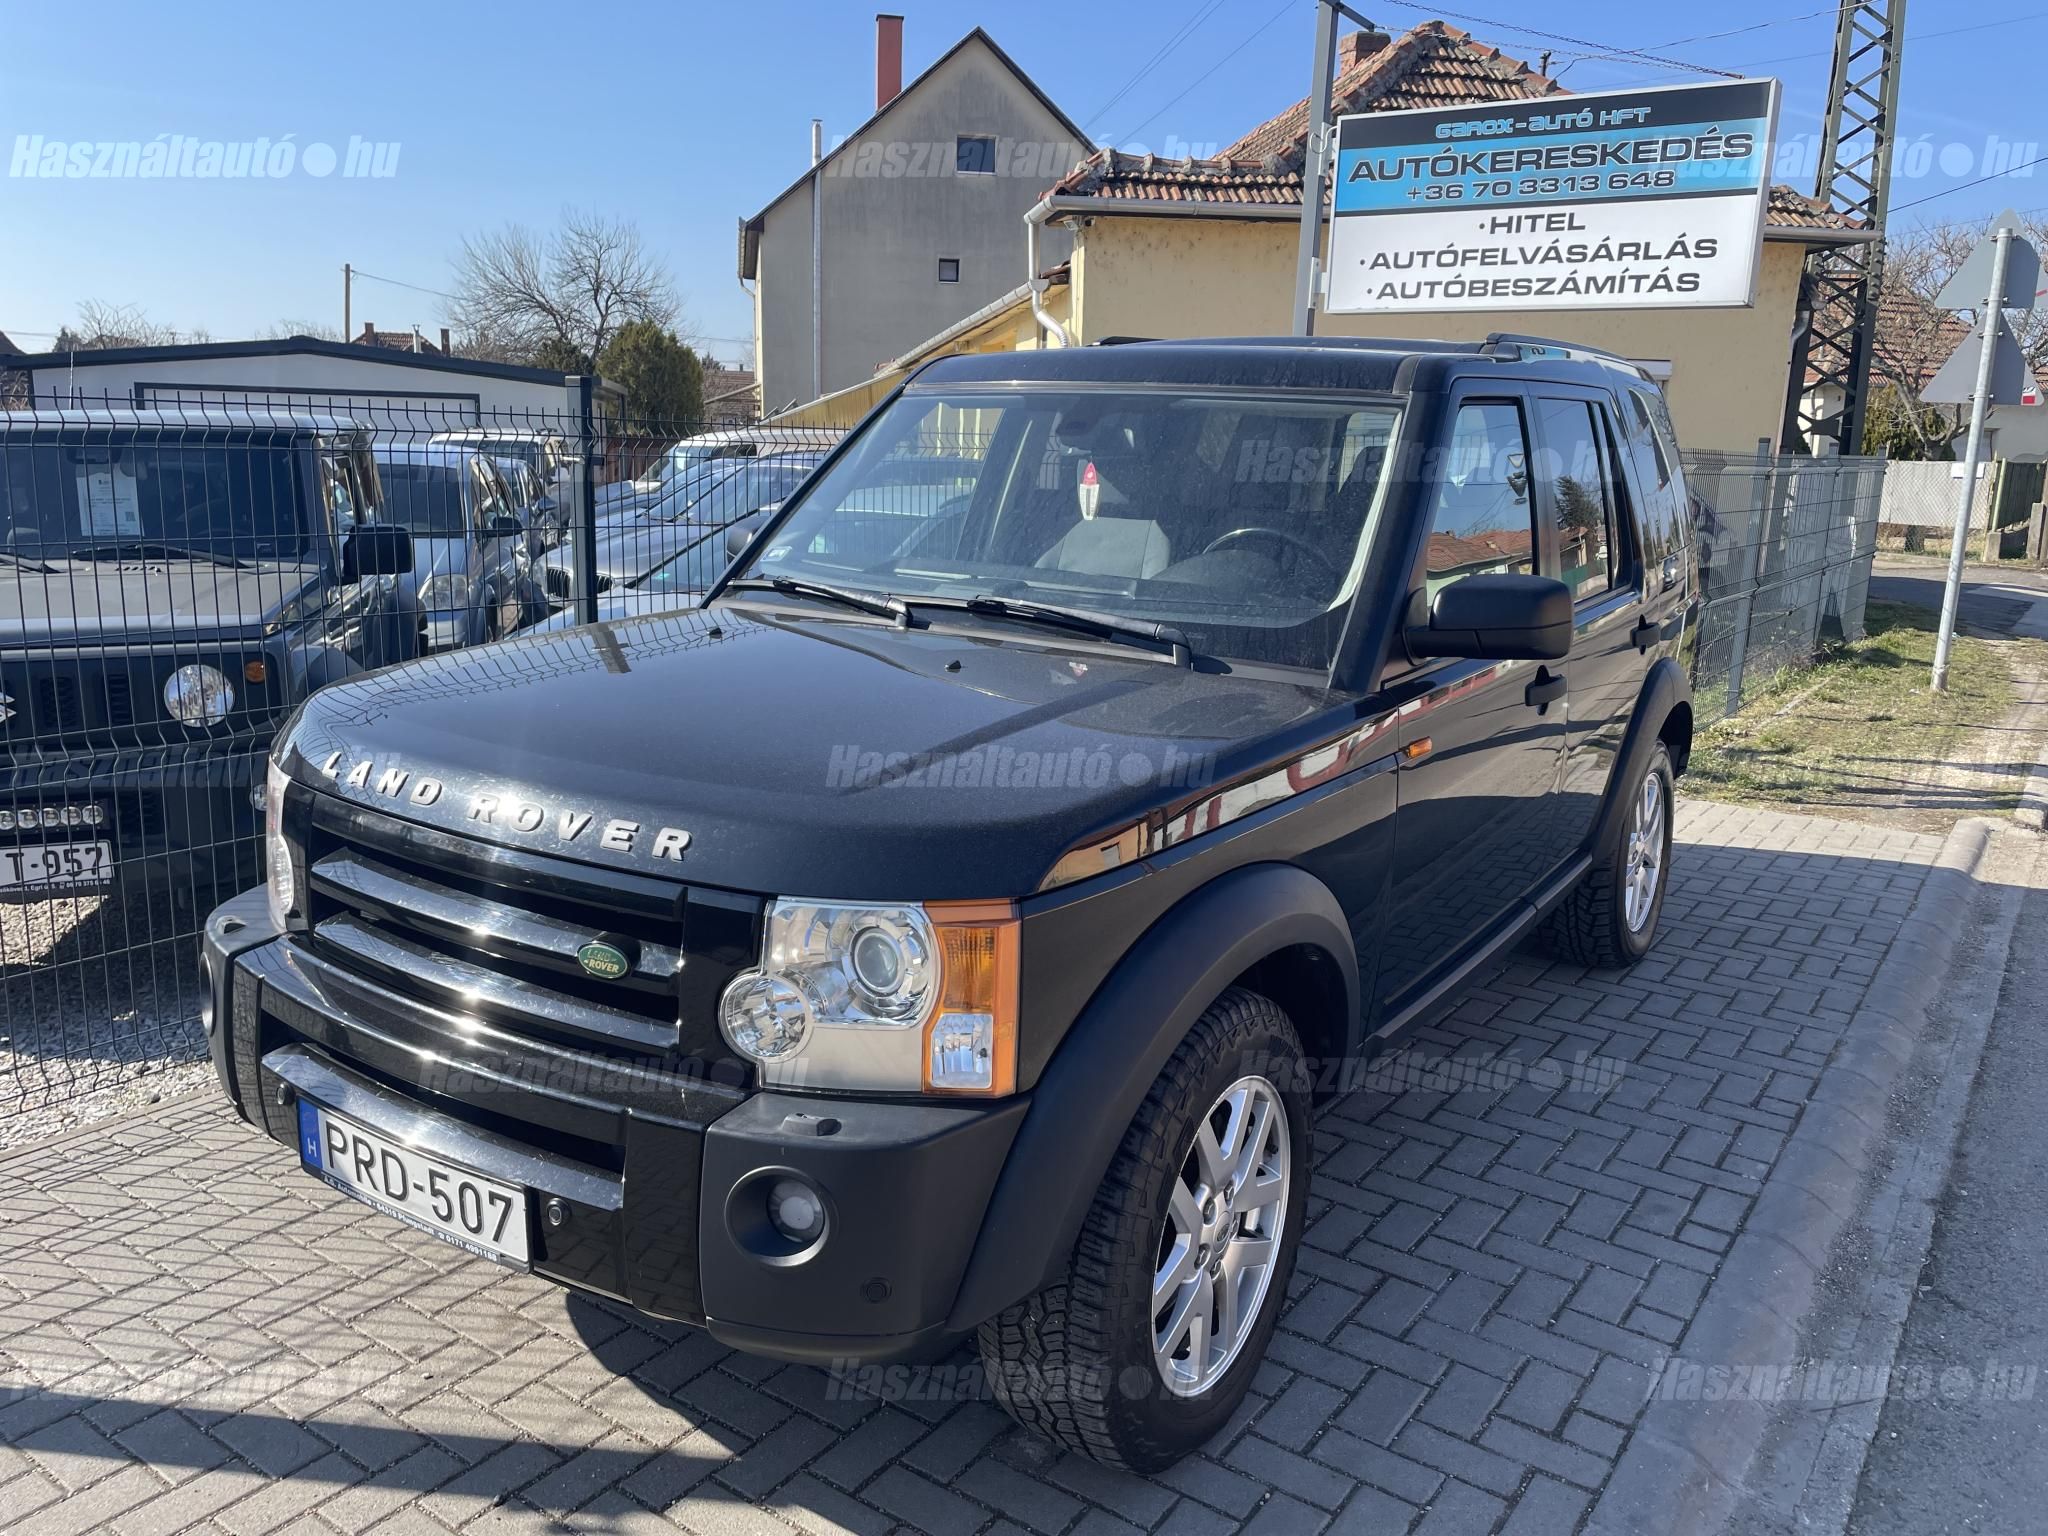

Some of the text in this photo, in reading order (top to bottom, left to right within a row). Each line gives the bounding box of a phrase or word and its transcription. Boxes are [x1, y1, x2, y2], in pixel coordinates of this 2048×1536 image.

[1348, 126, 1754, 183] AUTÓKERESKEDÉS
[1406, 169, 1676, 201] +36 70 3313 648
[321, 751, 693, 862] LAND ROVER
[588, 959, 620, 973] ROVER
[307, 1120, 513, 1243] H PRD-507
